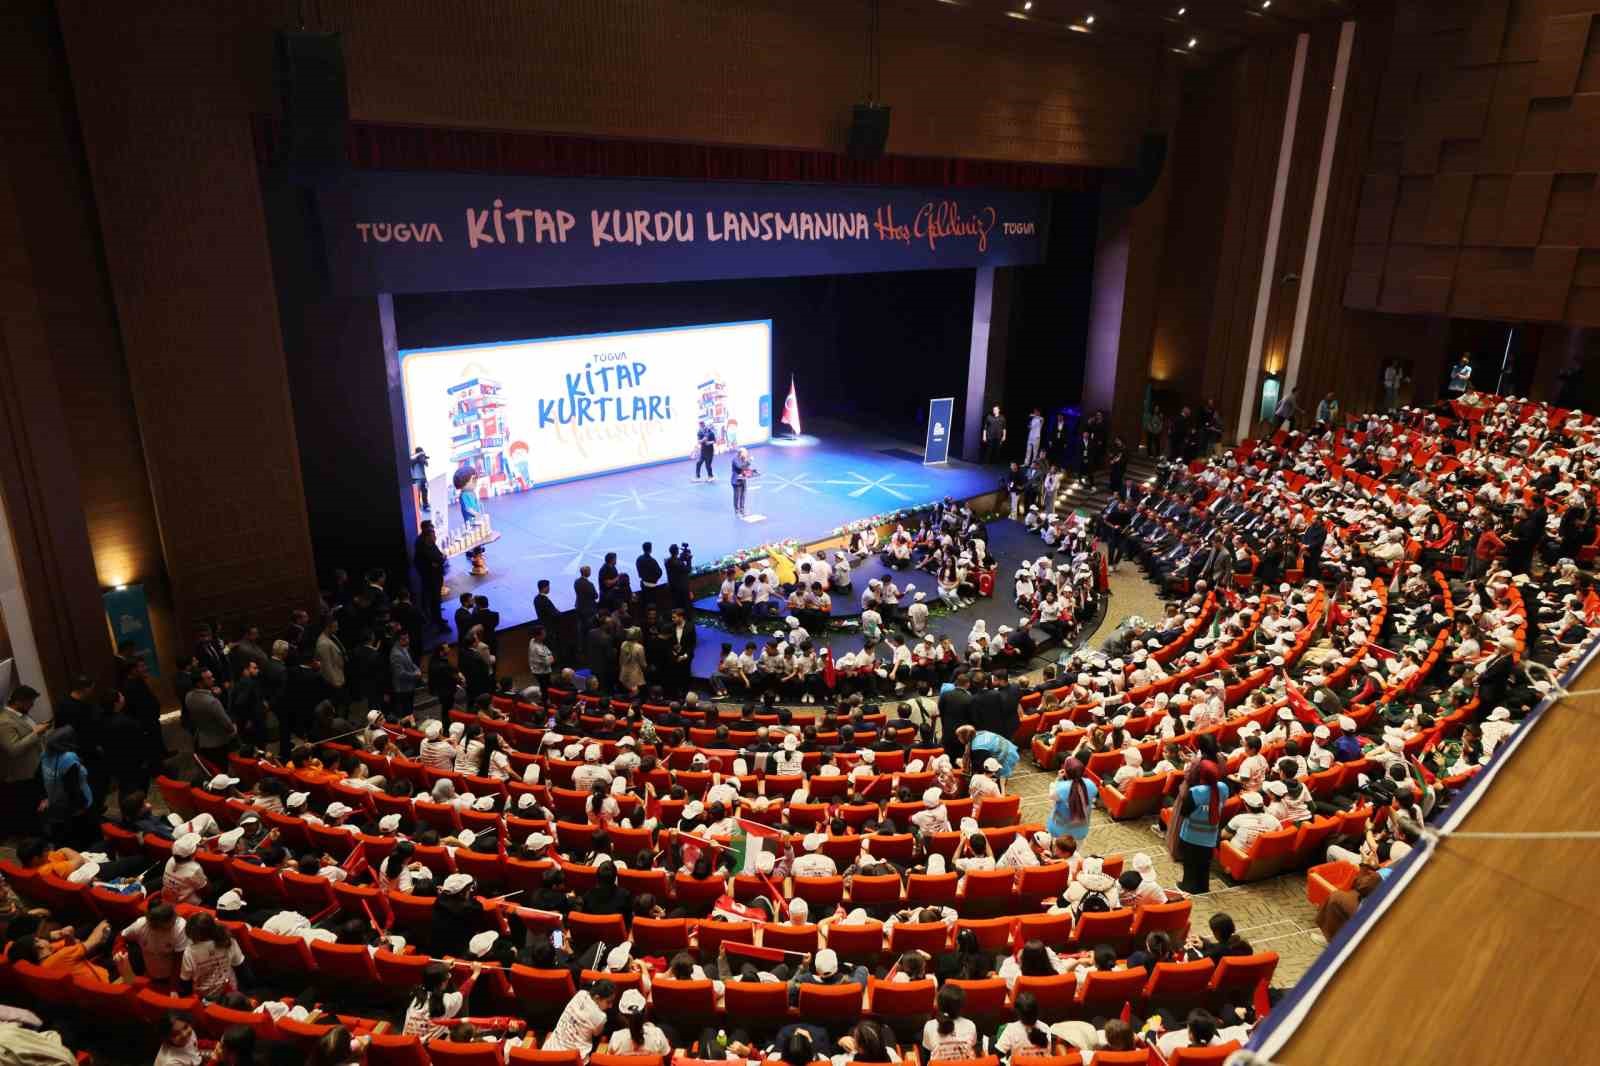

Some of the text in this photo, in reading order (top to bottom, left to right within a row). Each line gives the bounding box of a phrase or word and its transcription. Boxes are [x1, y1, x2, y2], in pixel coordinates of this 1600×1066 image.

[465, 198, 576, 249] KİTAP
[590, 209, 695, 247] KURDU
[706, 211, 870, 242] LANSMANINA
[565, 362, 647, 397] KİTAP
